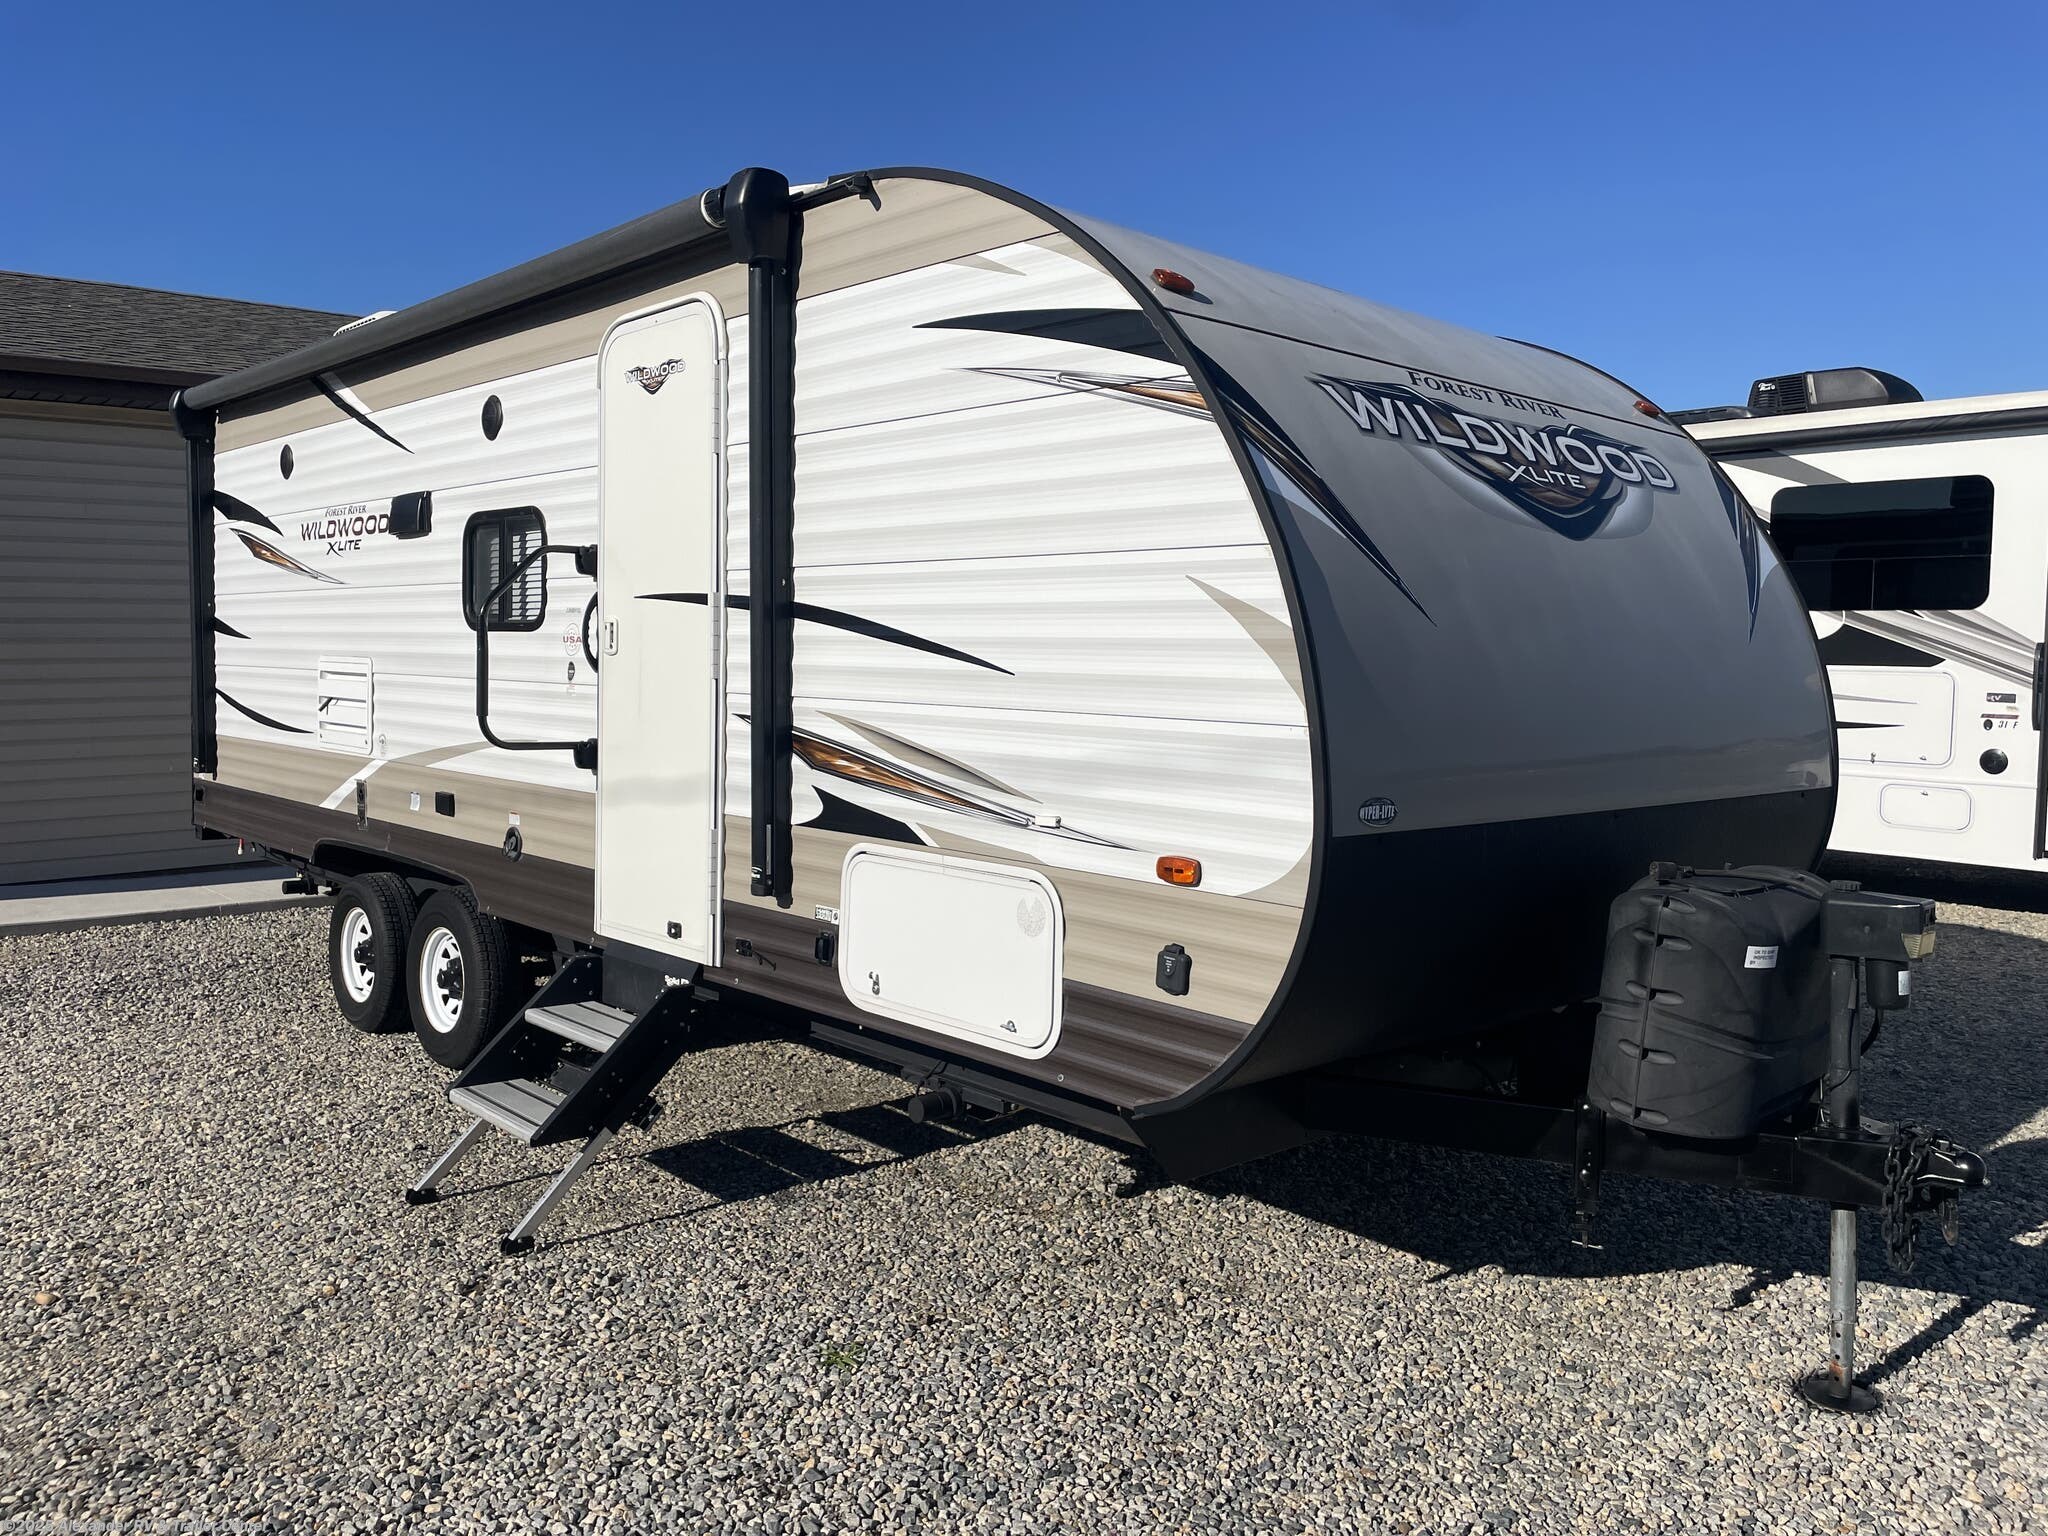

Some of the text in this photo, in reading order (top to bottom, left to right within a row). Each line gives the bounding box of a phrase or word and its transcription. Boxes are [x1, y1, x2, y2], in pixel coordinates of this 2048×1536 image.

[624, 361, 686, 384] WILDWOOD
[1407, 371, 1567, 420] FOREST RIVER
[1317, 380, 1677, 490] WILDWOOD
[1502, 461, 1587, 489] XLITE
[325, 505, 367, 517] FOREST RIVER
[301, 514, 390, 541] WILDWOOD
[326, 539, 362, 557] XLITE
[563, 636, 582, 644] USA
